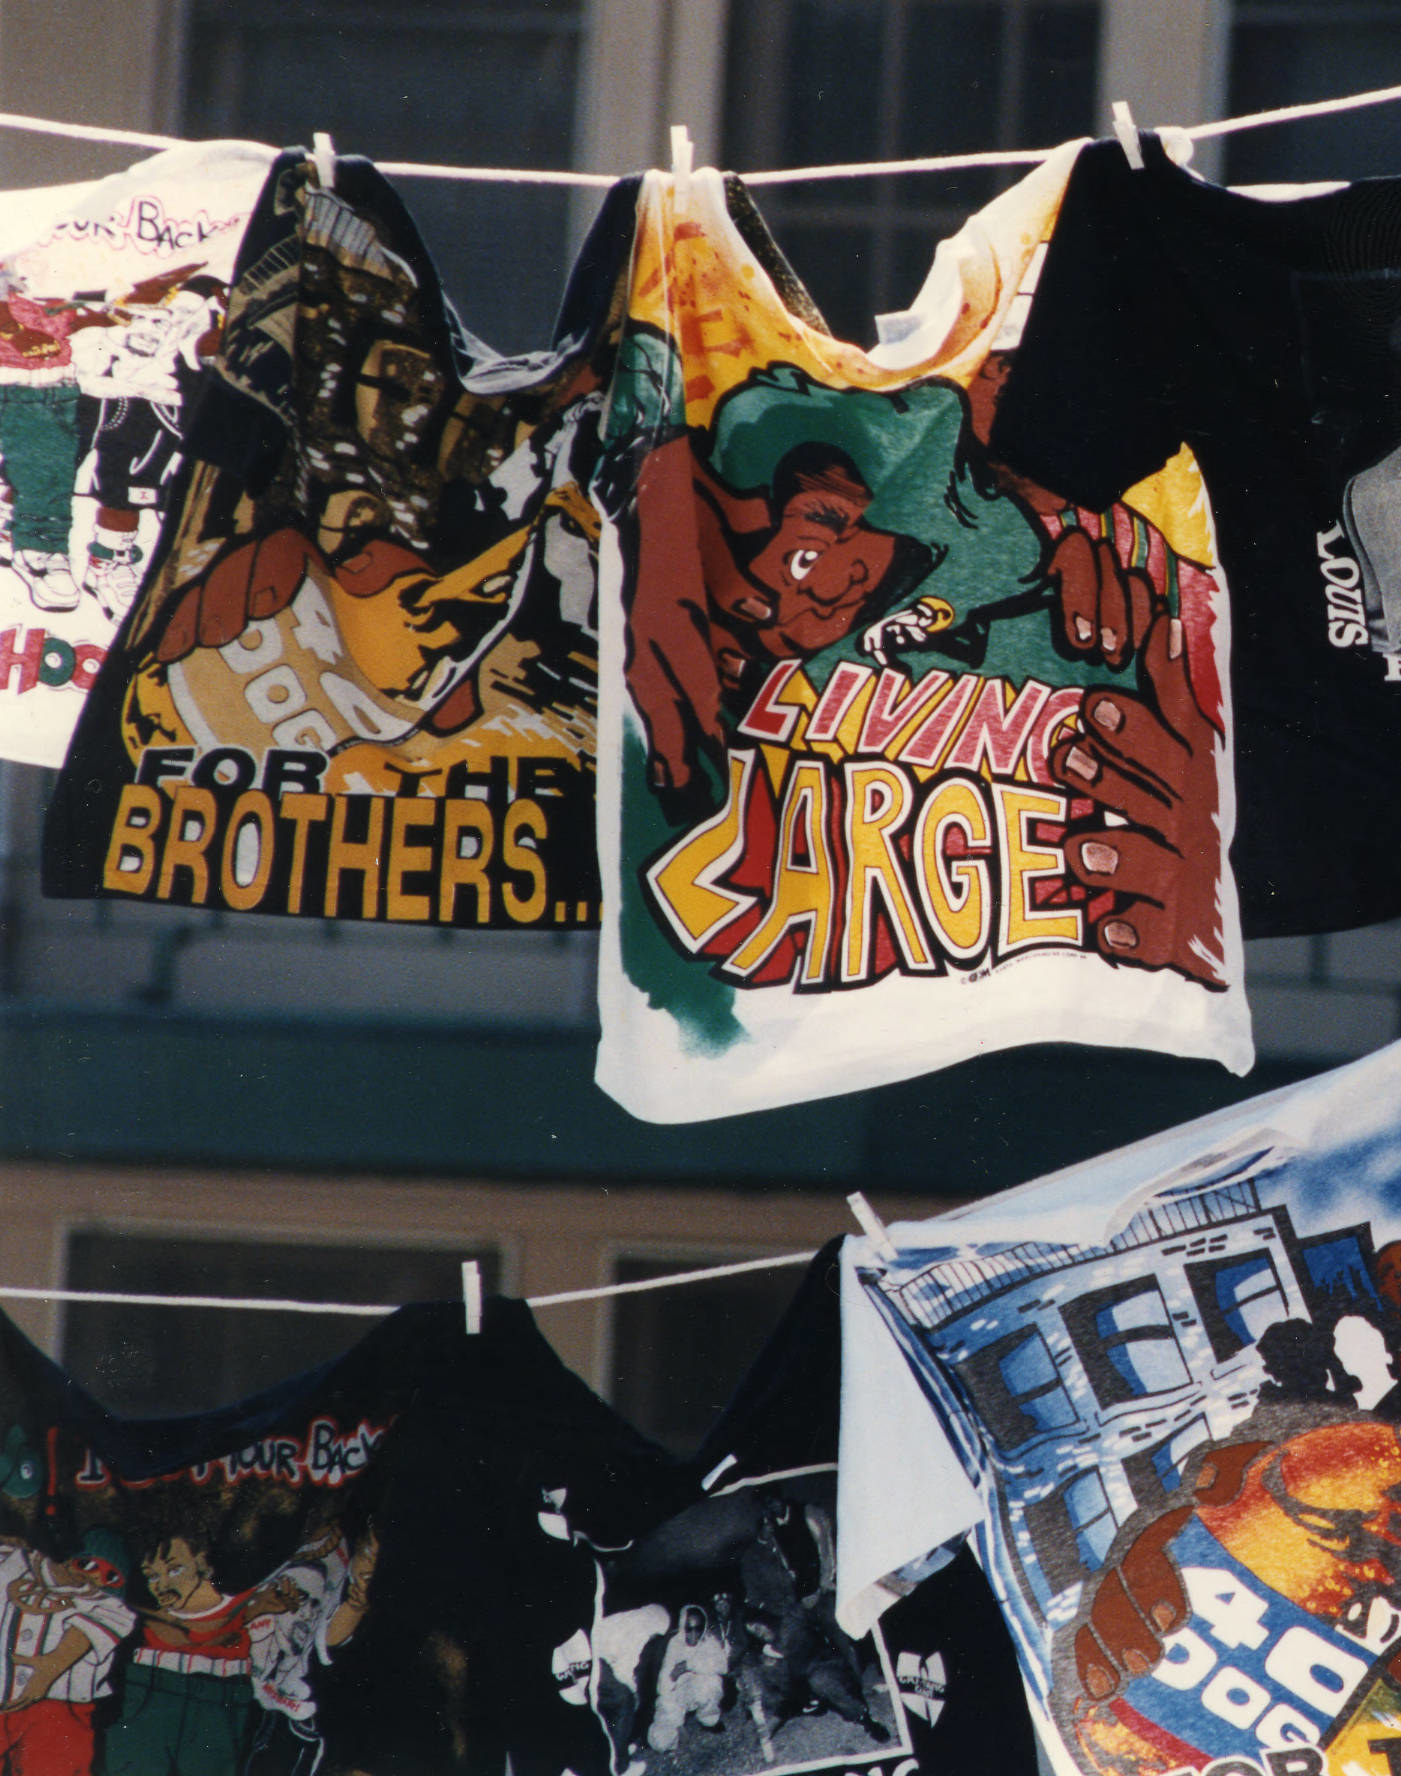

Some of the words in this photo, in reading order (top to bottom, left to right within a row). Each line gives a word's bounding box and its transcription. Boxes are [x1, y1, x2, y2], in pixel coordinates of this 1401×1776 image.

[1316, 520, 1369, 648] LOUIS
[137, 747, 329, 795] FOR
[384, 754, 575, 800] THE
[645, 748, 1083, 984] LARGE
[310, 1421, 385, 1477] BACK
[1181, 1566, 1369, 1718] 40
